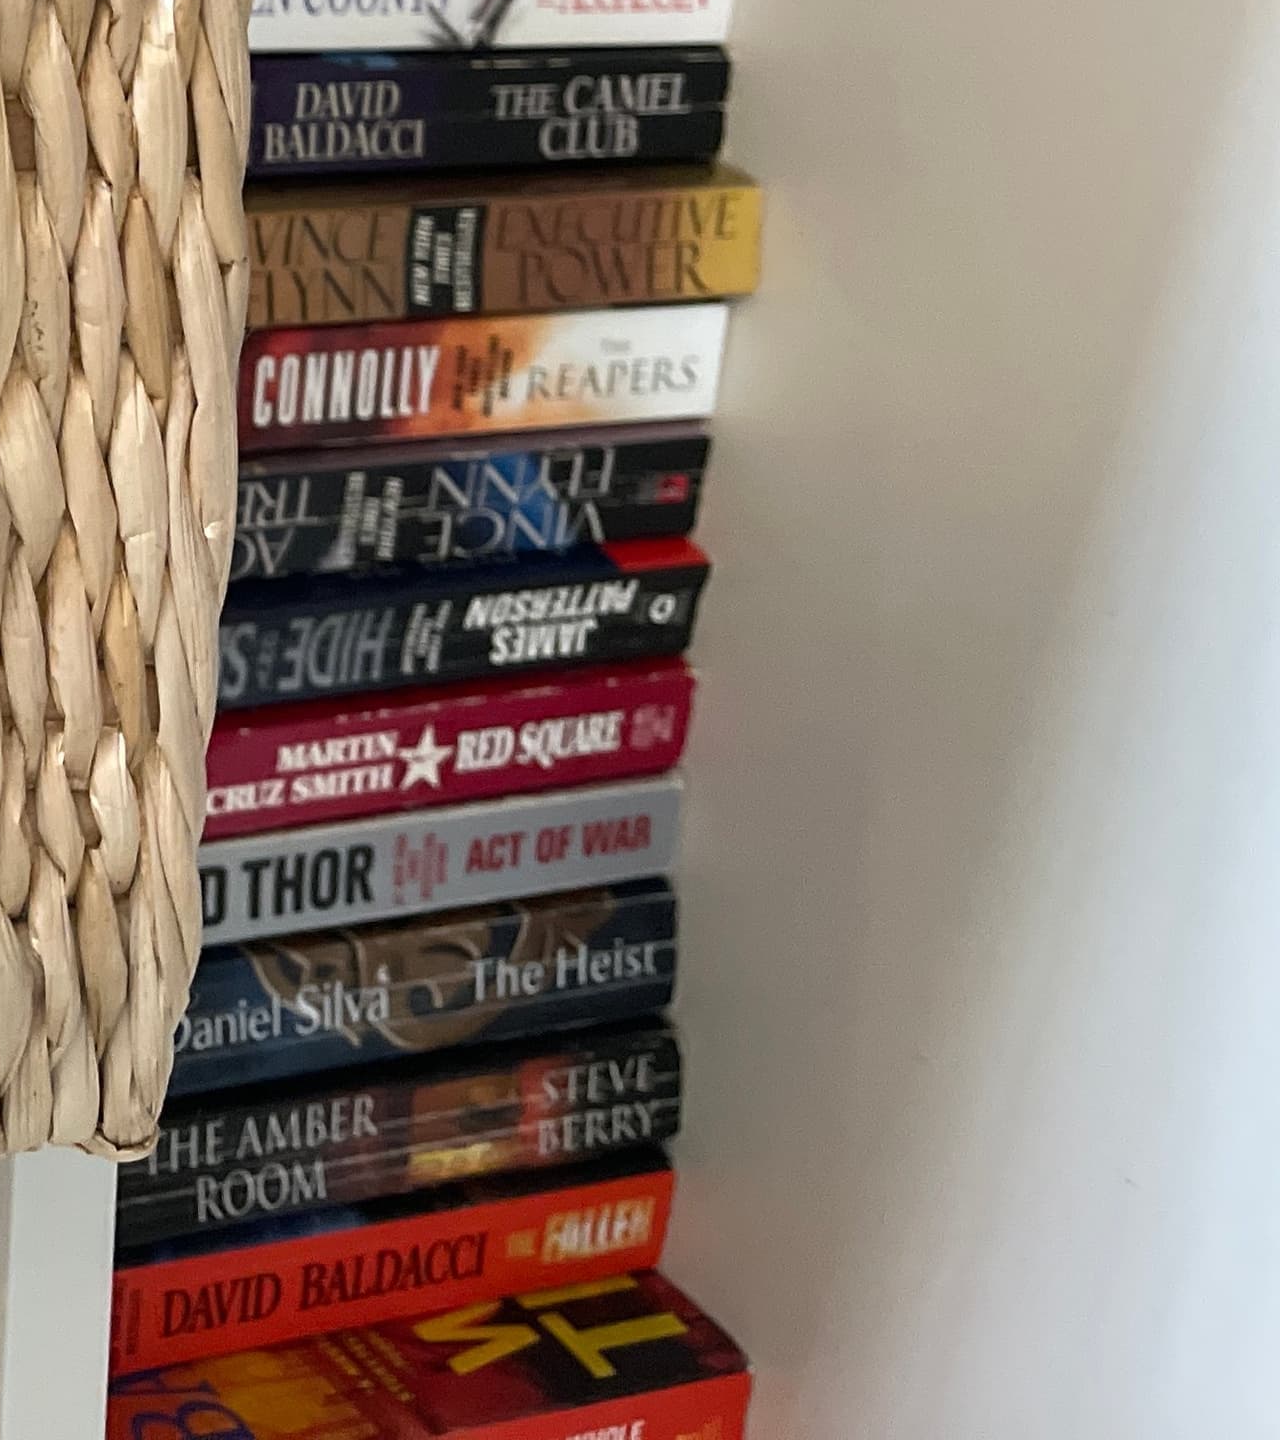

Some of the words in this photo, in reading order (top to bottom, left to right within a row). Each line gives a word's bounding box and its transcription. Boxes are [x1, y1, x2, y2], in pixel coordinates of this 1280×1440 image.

[296, 81, 402, 120] DAVID
[490, 83, 559, 120] THE
[563, 74, 692, 117] CAMEL
[264, 119, 425, 160] BALDACCI
[540, 114, 640, 160] CLUB
[252, 212, 394, 265] VINCE
[496, 192, 741, 251] EXECUTIVE
[514, 240, 708, 304] POWER
[253, 345, 441, 428] CONNOLLY
[526, 352, 701, 404] REAPERS
[240, 477, 321, 527] TRE
[426, 446, 616, 513] FLYNN
[234, 528, 296, 580] AC
[421, 501, 604, 563] VINCE
[463, 578, 638, 630] PATTERSON
[277, 608, 396, 693] HIDE
[489, 617, 601, 666] JAMES
[276, 731, 401, 773] MARTIN
[454, 725, 518, 773] RED
[518, 710, 627, 770] SQUARE
[205, 777, 285, 816] CRUZ
[290, 763, 395, 806] SMITH
[465, 830, 527, 874] ACT
[534, 823, 574, 863] OF
[580, 814, 652, 857] WAR
[243, 844, 376, 920] THOR
[469, 957, 543, 1002] The
[554, 936, 659, 990] Heist
[293, 980, 391, 1038] Silva
[541, 1053, 658, 1108] STEVE
[151, 1116, 225, 1176] THE
[239, 1092, 379, 1154] AMBER
[539, 1100, 659, 1156] BERRY
[195, 1166, 329, 1224] ROOM
[542, 1195, 658, 1265] FALLEN
[160, 1271, 283, 1338] DAVID
[297, 1230, 489, 1311] BALDACCI
